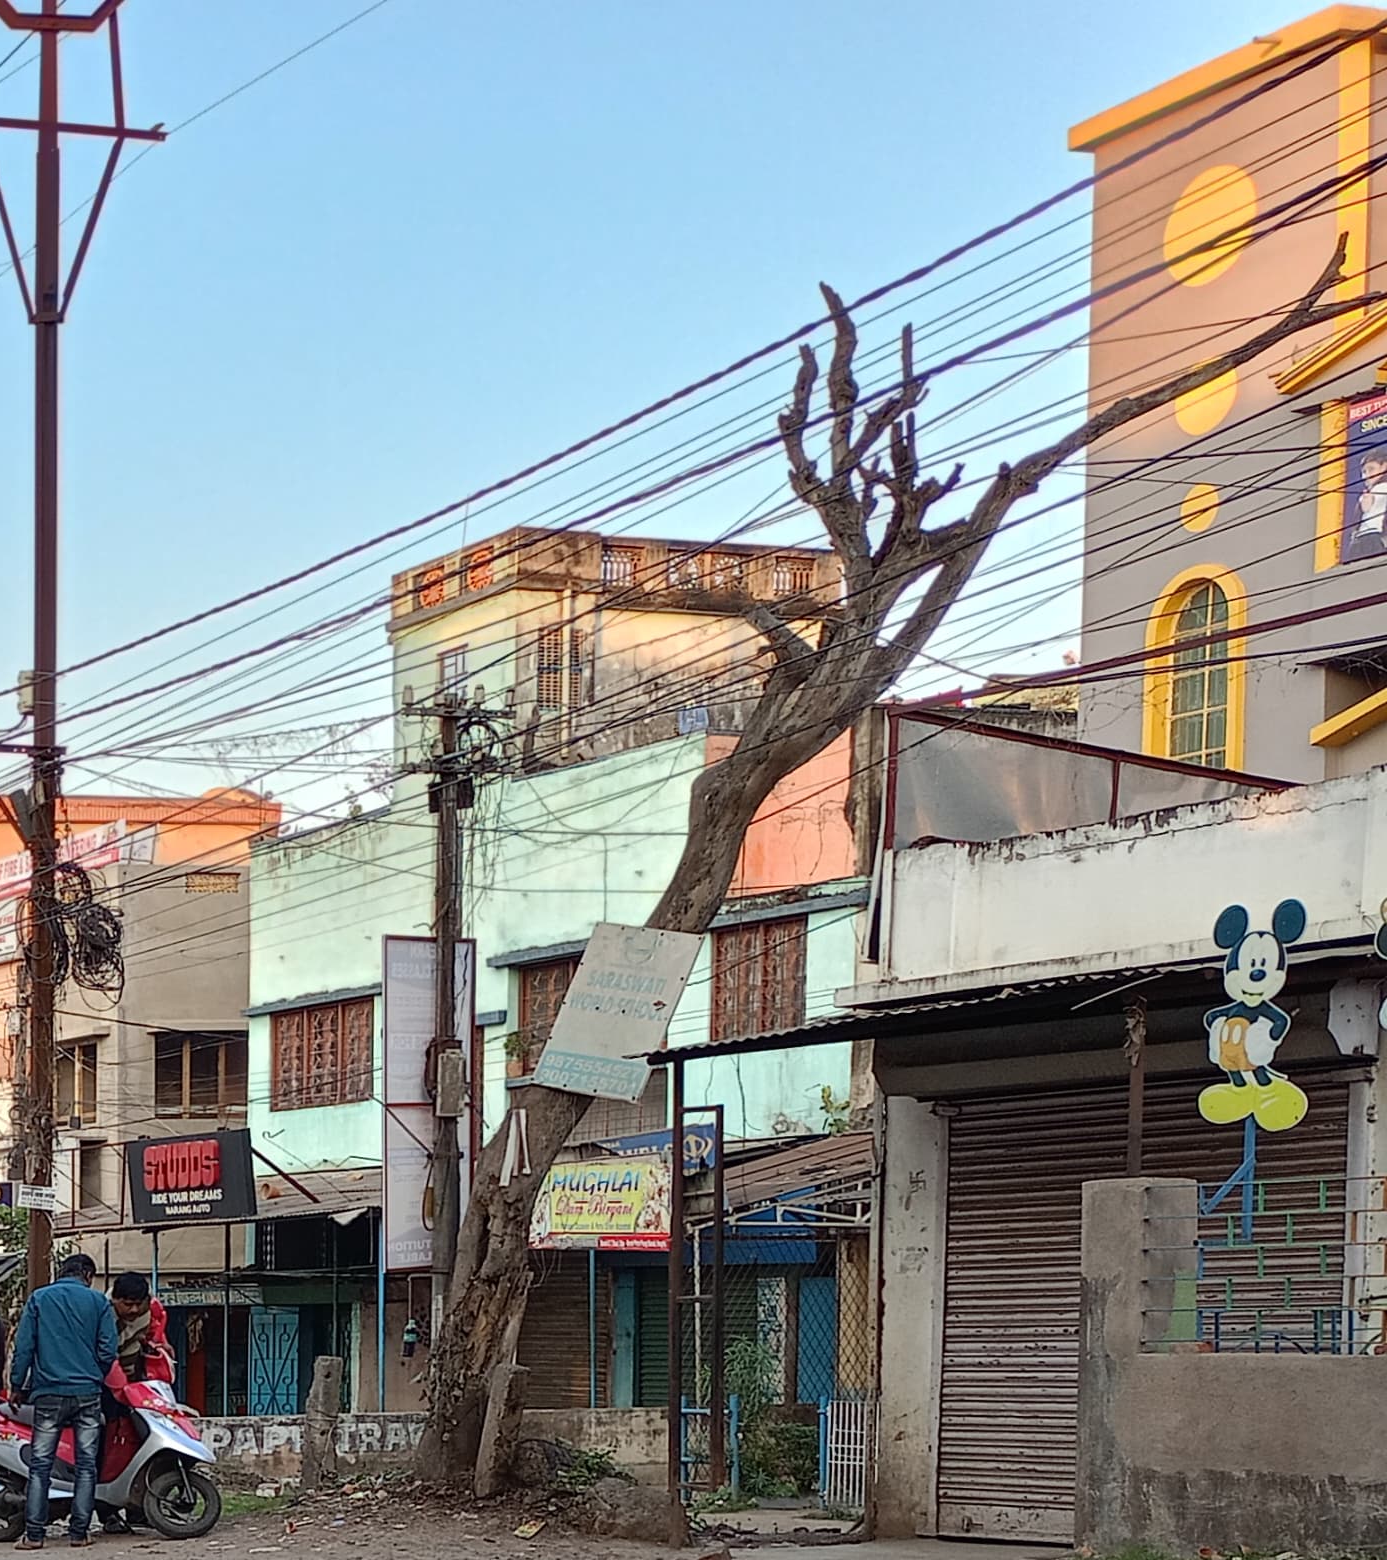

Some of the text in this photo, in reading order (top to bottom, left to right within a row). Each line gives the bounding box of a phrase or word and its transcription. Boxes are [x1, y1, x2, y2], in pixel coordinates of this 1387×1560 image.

[587, 969, 667, 995] SARASWATI
[569, 991, 663, 1022] WORLD SCHOOL
[143, 1139, 220, 1192] STUDDS
[551, 1169, 641, 1196] MUGHLAI
[151, 1189, 223, 1205] RIDE YOUR DREAMS
